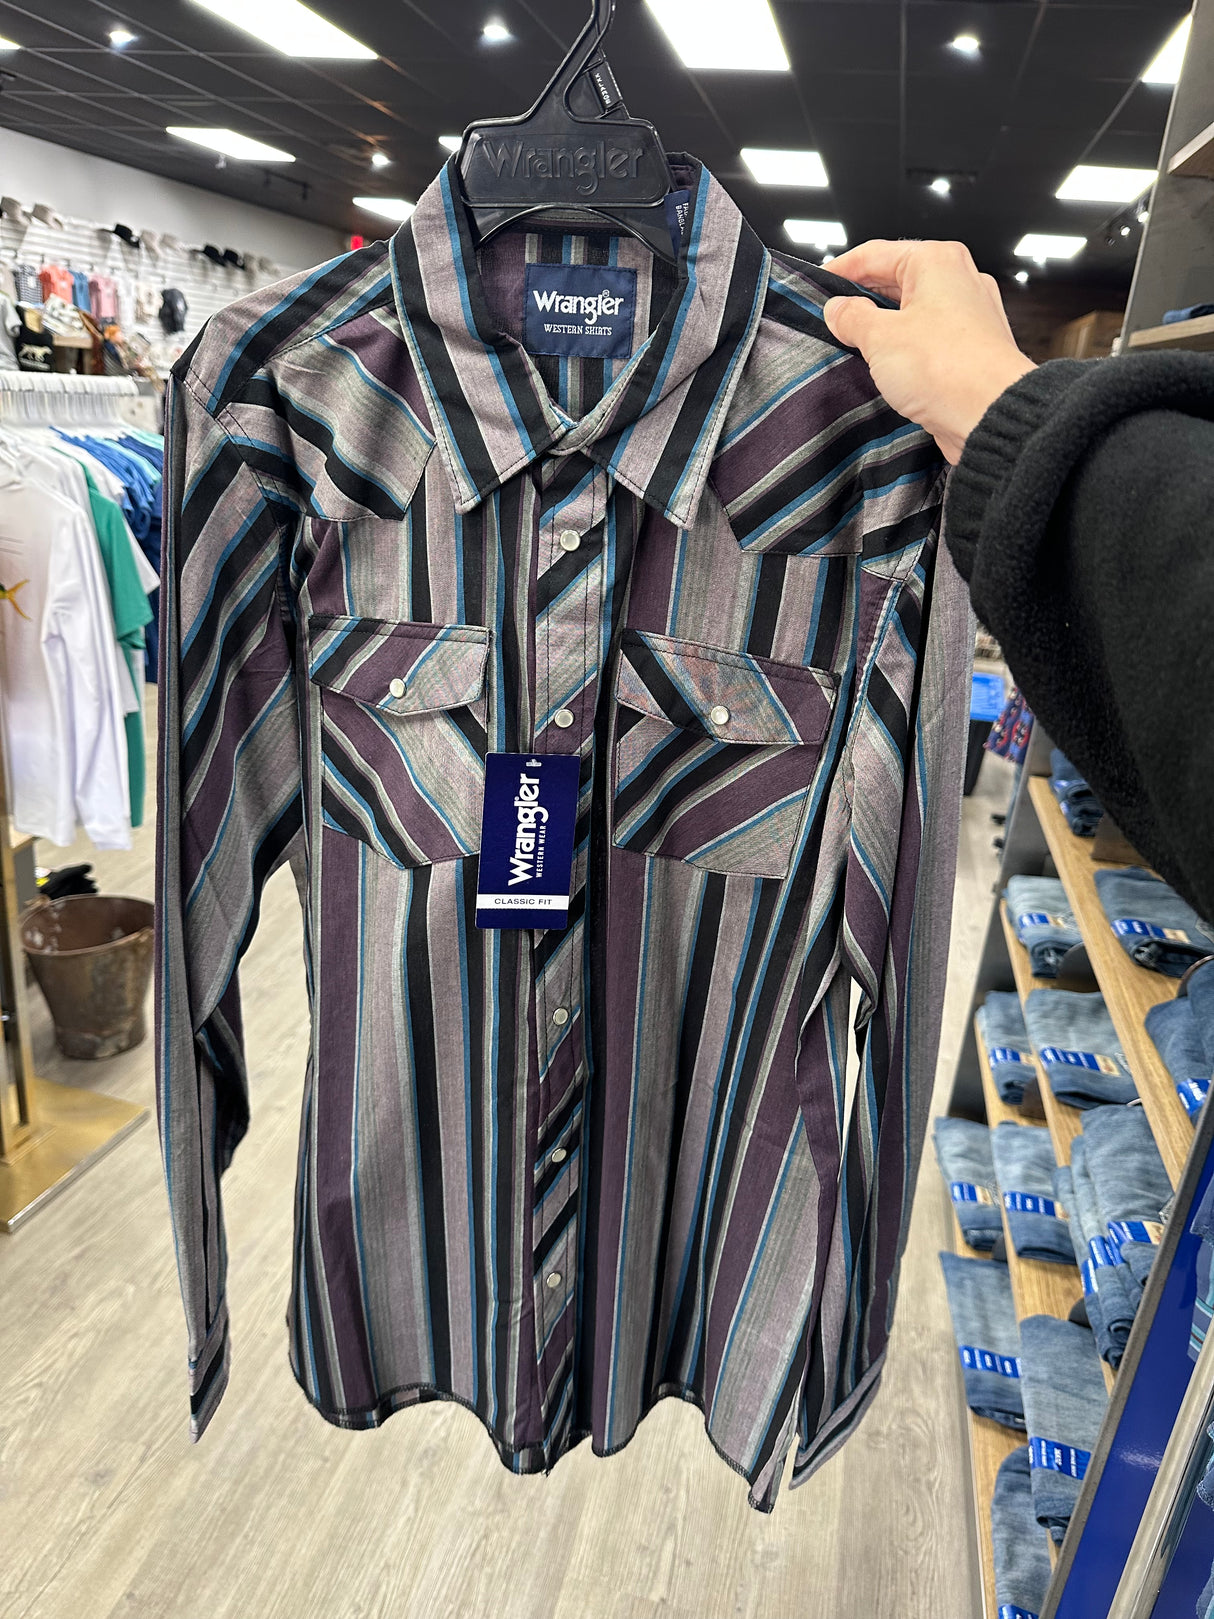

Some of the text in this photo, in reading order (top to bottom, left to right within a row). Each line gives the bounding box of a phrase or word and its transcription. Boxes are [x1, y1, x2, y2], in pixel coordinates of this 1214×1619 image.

[482, 140, 645, 196] Wrangler
[532, 290, 624, 325] Wrangler
[543, 323, 613, 336] WESTERN SHIRTS
[508, 773, 549, 887] Wrangler
[535, 825, 547, 878] WESTERN WEAR
[494, 898, 552, 906] CLASSIC FIT
